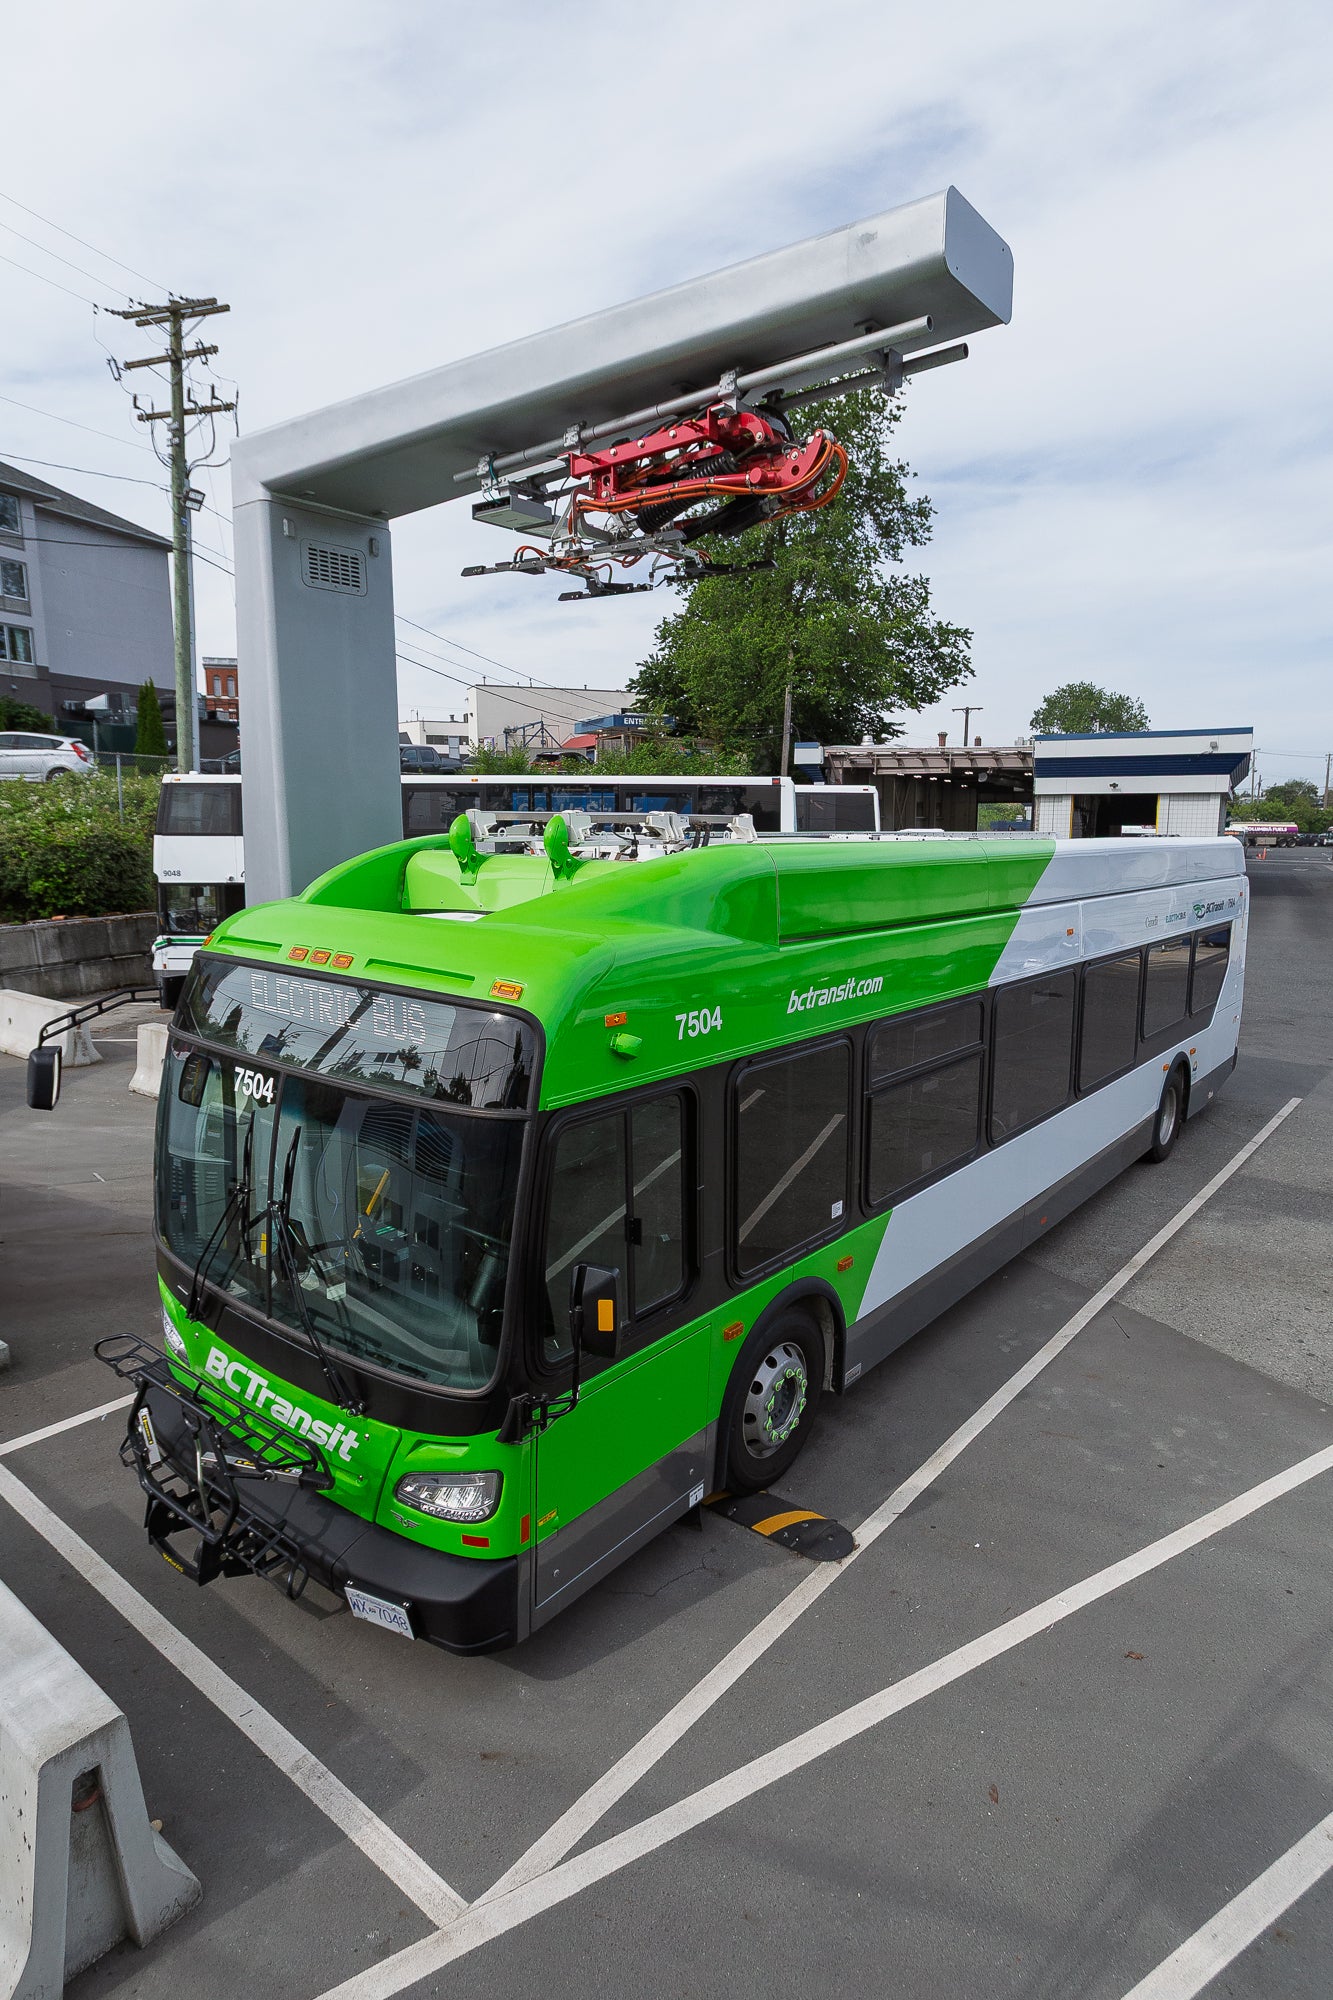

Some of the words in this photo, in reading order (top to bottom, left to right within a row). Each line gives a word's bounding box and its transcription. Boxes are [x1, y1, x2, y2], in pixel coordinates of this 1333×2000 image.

[623, 717, 665, 726] ENTRCE
[251, 973, 361, 1030] ELECTRIC
[373, 996, 426, 1045] BUS
[787, 976, 884, 1014] bctransit.com
[675, 1005, 722, 1040] 7504
[234, 1066, 275, 1103] 7504
[204, 1346, 359, 1462] BCTransit
